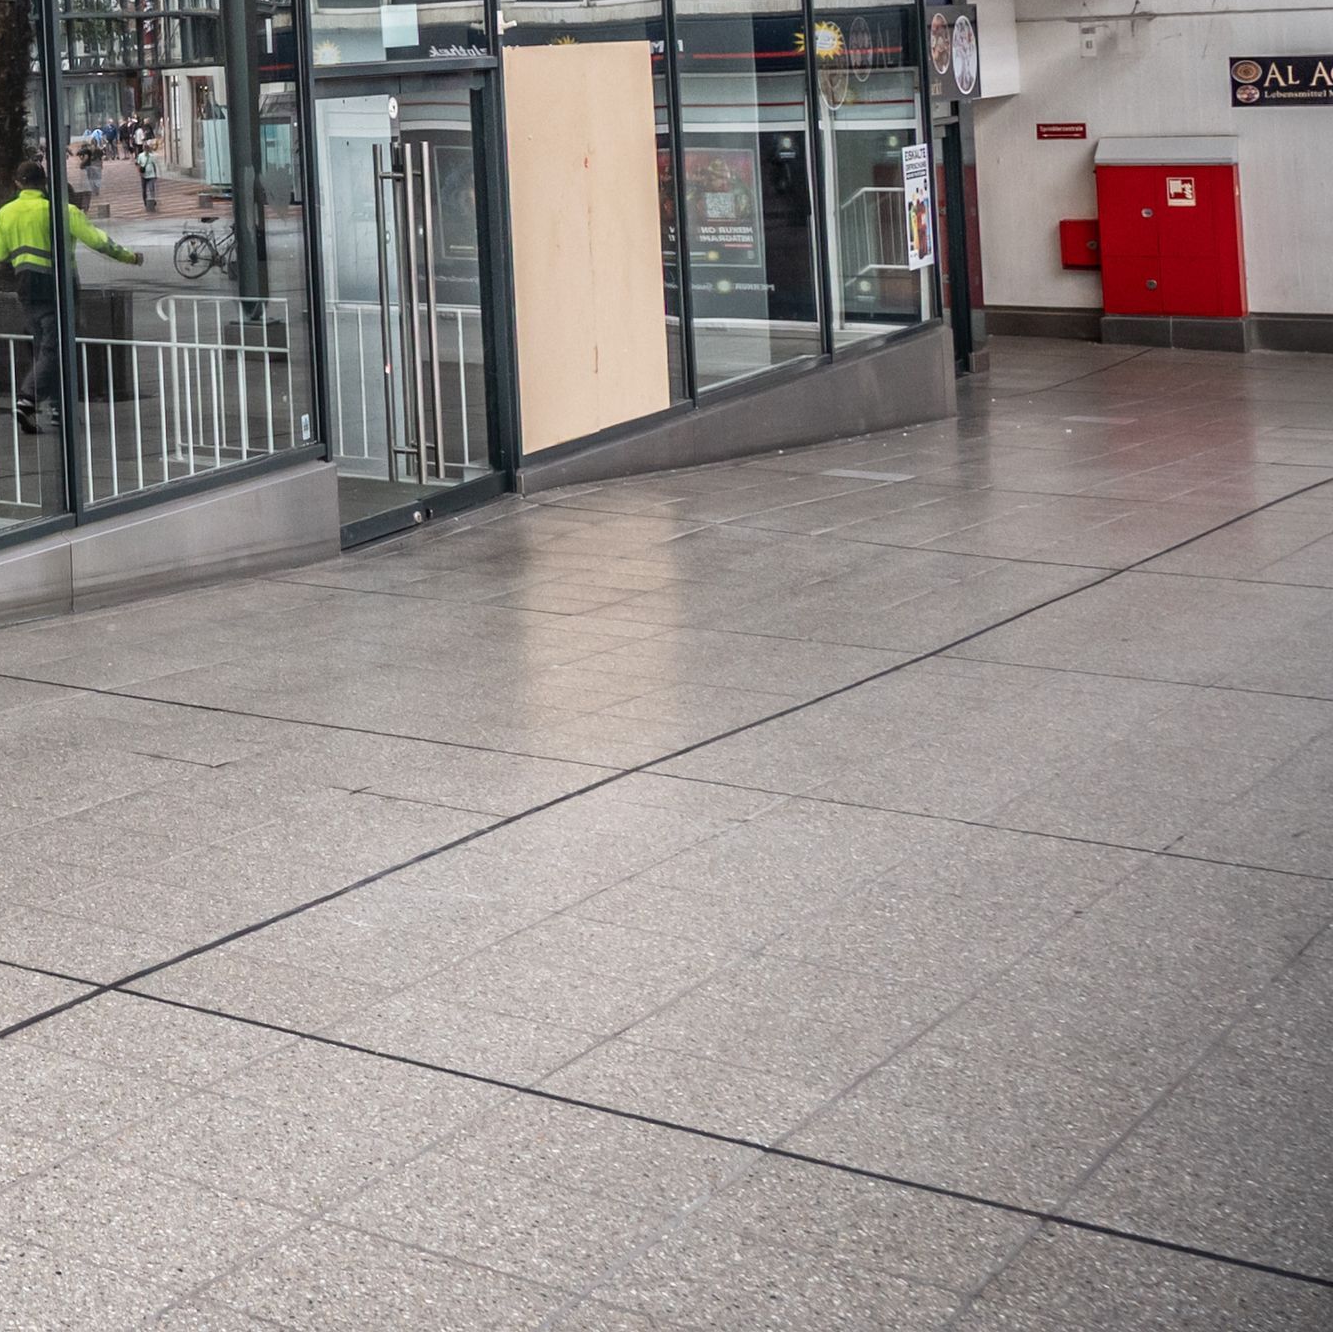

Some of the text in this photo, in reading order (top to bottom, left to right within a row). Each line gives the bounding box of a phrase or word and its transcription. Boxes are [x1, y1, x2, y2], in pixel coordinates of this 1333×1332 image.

[1263, 61, 1333, 87] AL A
[1264, 90, 1327, 99] Lebensmittel
